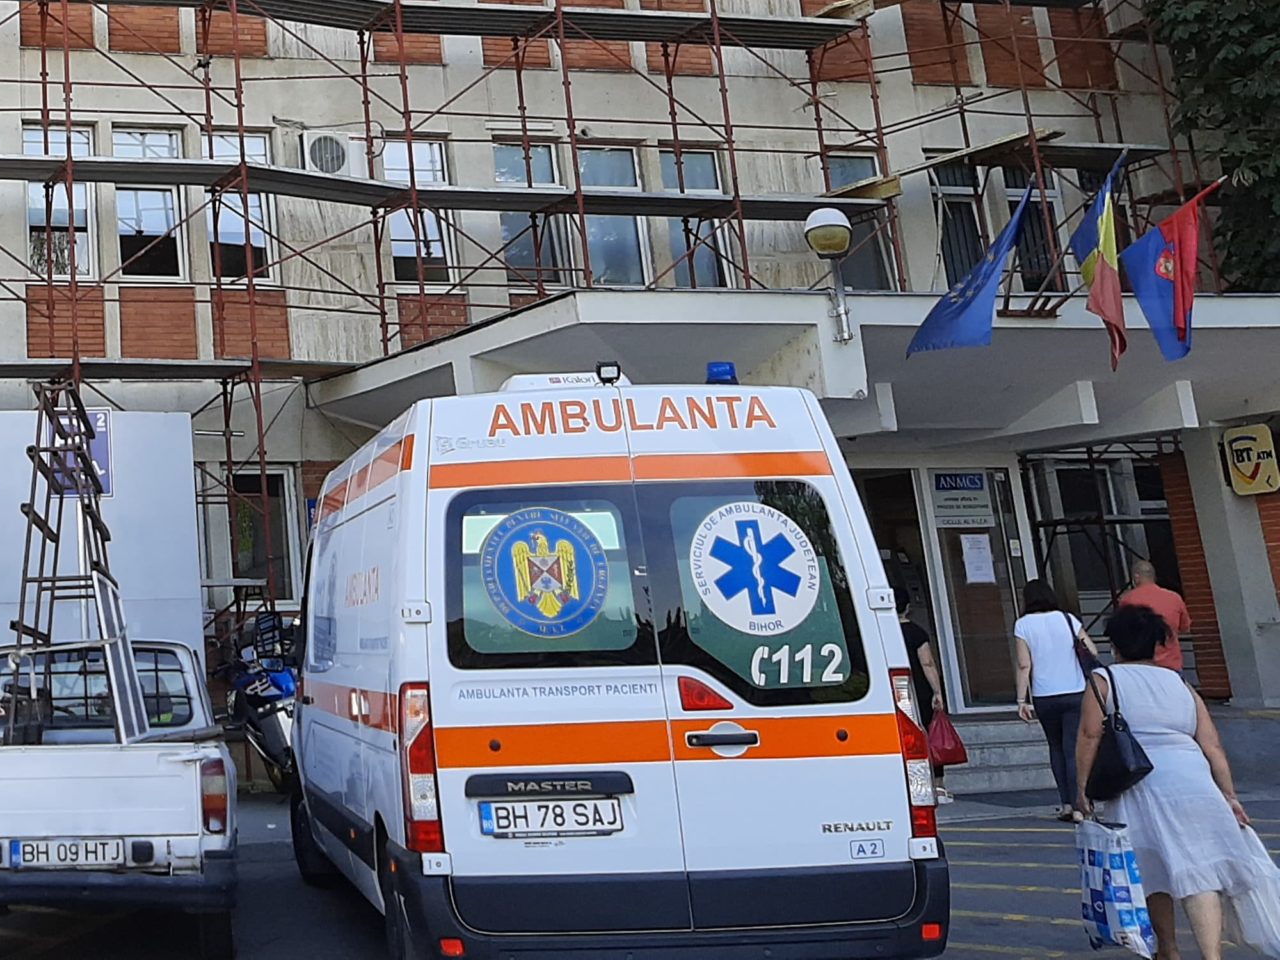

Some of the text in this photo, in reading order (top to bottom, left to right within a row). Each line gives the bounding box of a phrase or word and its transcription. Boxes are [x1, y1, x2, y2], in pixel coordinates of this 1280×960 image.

[96, 413, 106, 427] 2
[487, 395, 777, 438] AMBULANTA
[1233, 447, 1273, 463] BT ATM
[939, 475, 982, 489] ANMCS
[691, 504, 817, 596] SERVICIUL DE AMBULANTA JUDETEAN
[749, 619, 784, 632] BIHOR
[771, 643, 844, 684] 112
[458, 682, 659, 700] AMBULANTA TRANSPORT PACIENTI
[506, 780, 593, 793] MASTER
[494, 805, 530, 830] BH
[537, 804, 566, 828] 78
[573, 802, 618, 827] SAJ
[821, 820, 894, 833] RENAULT
[22, 842, 120, 862] BH 09 HTJ
[856, 842, 878, 856] A 2
